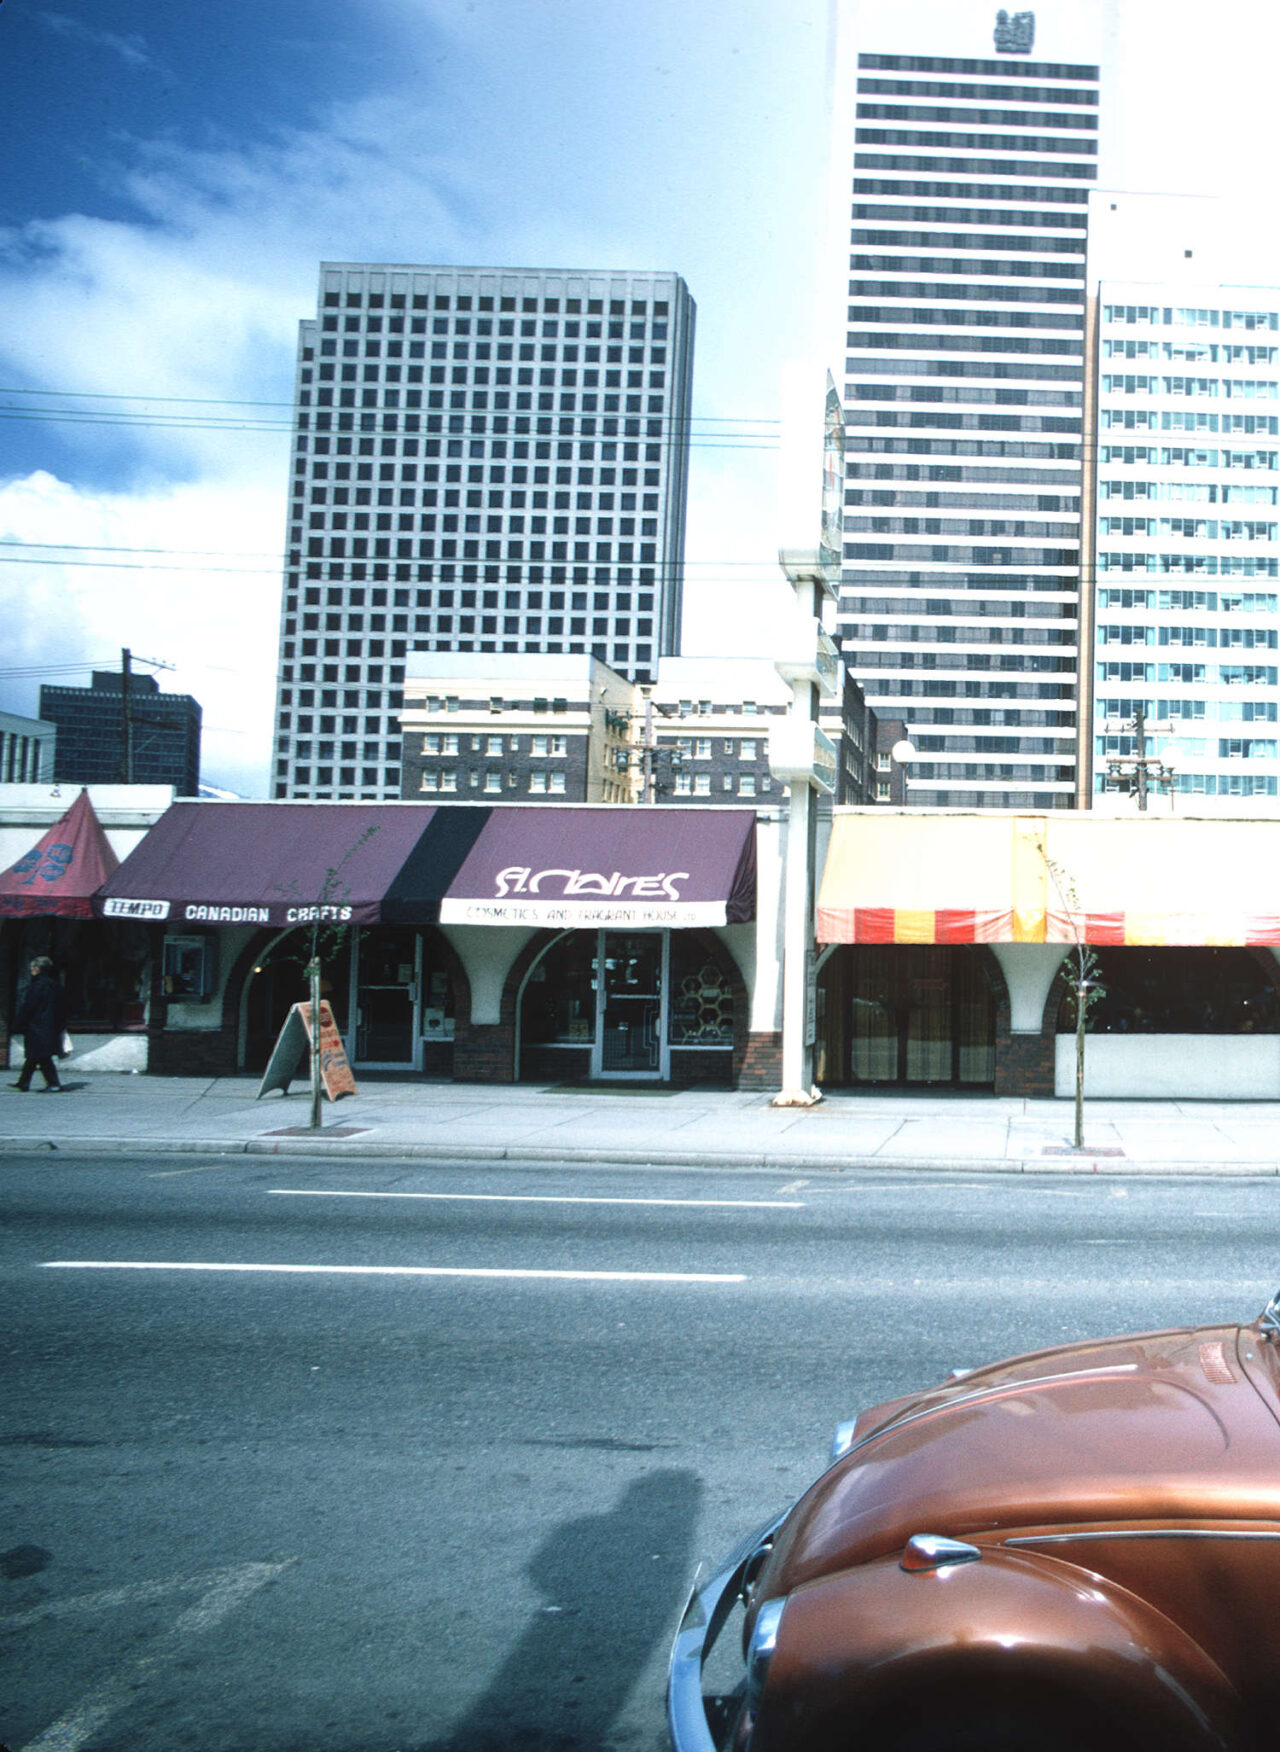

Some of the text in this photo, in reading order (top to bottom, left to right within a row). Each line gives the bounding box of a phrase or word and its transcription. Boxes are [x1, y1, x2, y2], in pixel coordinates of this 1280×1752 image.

[110, 900, 163, 916] TEMPO
[185, 905, 353, 922] CANADIAN CRAFTS
[465, 906, 540, 920] COSMETICS
[546, 907, 573, 921] AND
[643, 909, 678, 921] HOUSE
